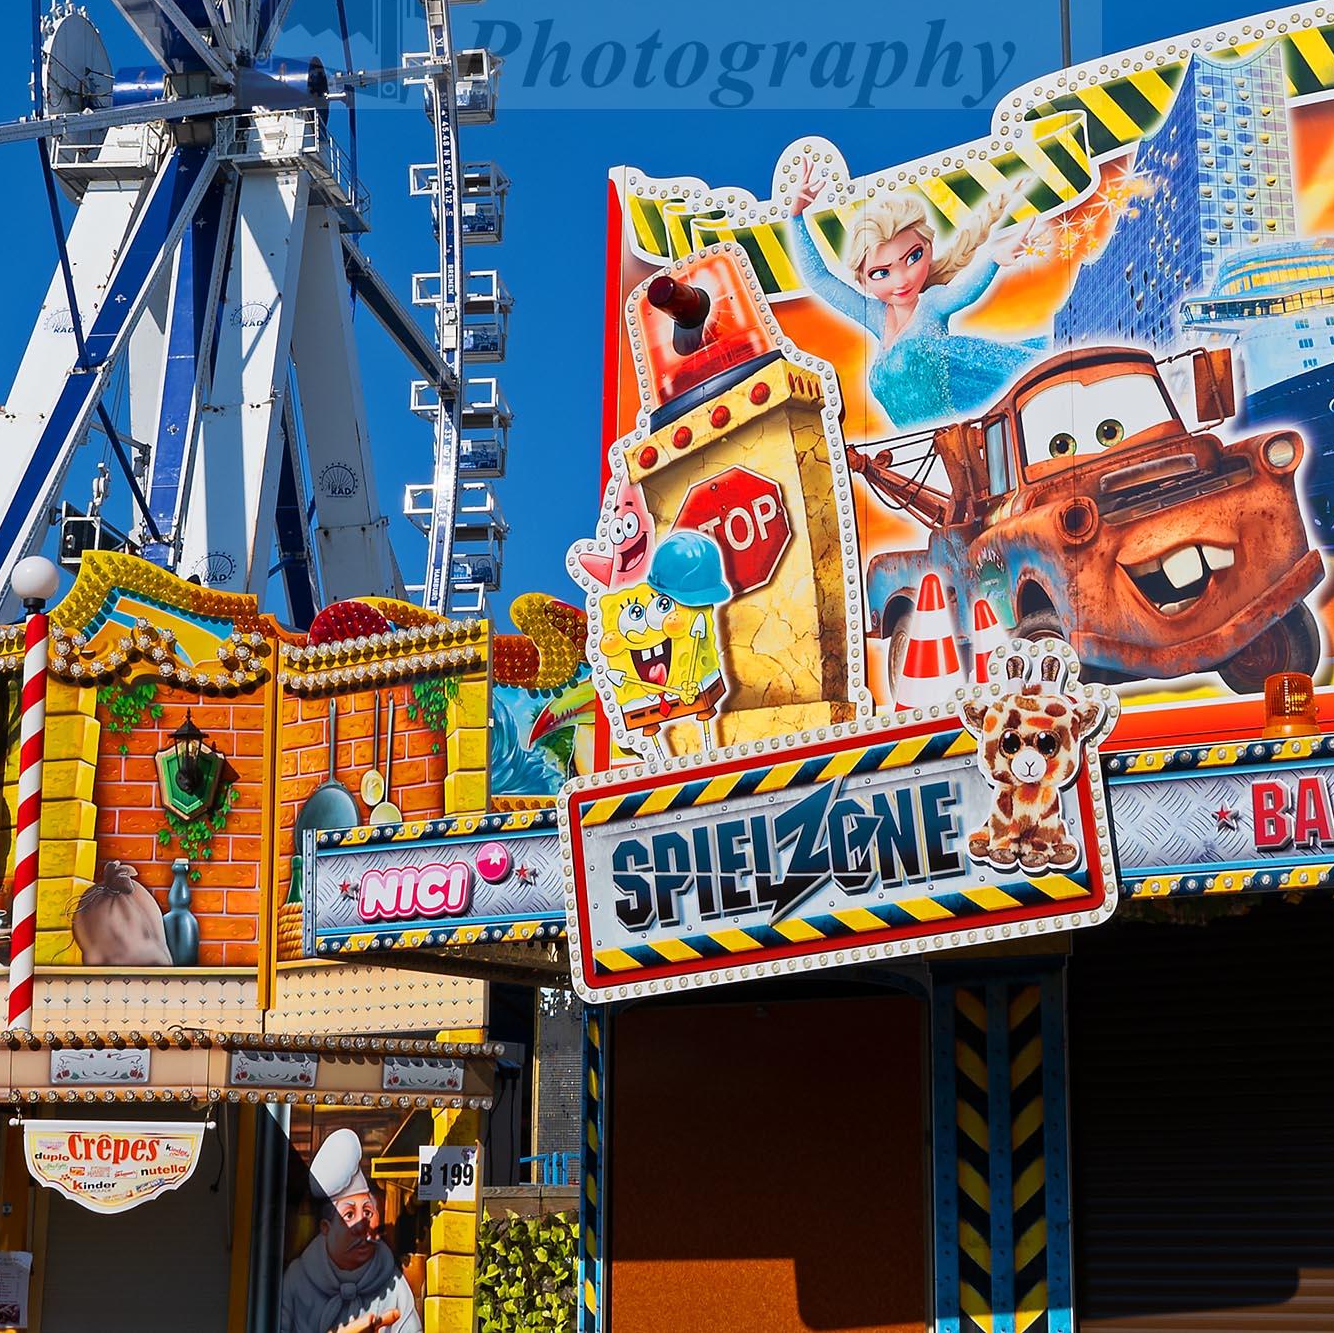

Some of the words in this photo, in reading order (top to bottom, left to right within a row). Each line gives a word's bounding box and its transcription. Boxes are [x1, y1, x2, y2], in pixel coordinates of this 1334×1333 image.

[698, 497, 777, 555] TOP
[430, 567, 441, 601] HAMBURG
[611, 775, 964, 933] SPIELZONE
[357, 862, 472, 924] NICI
[34, 1152, 70, 1163] duplo
[68, 1132, 160, 1165] Crêpes
[140, 1164, 187, 1177] nutella
[419, 1163, 433, 1186] B
[440, 1163, 474, 1187] 199
